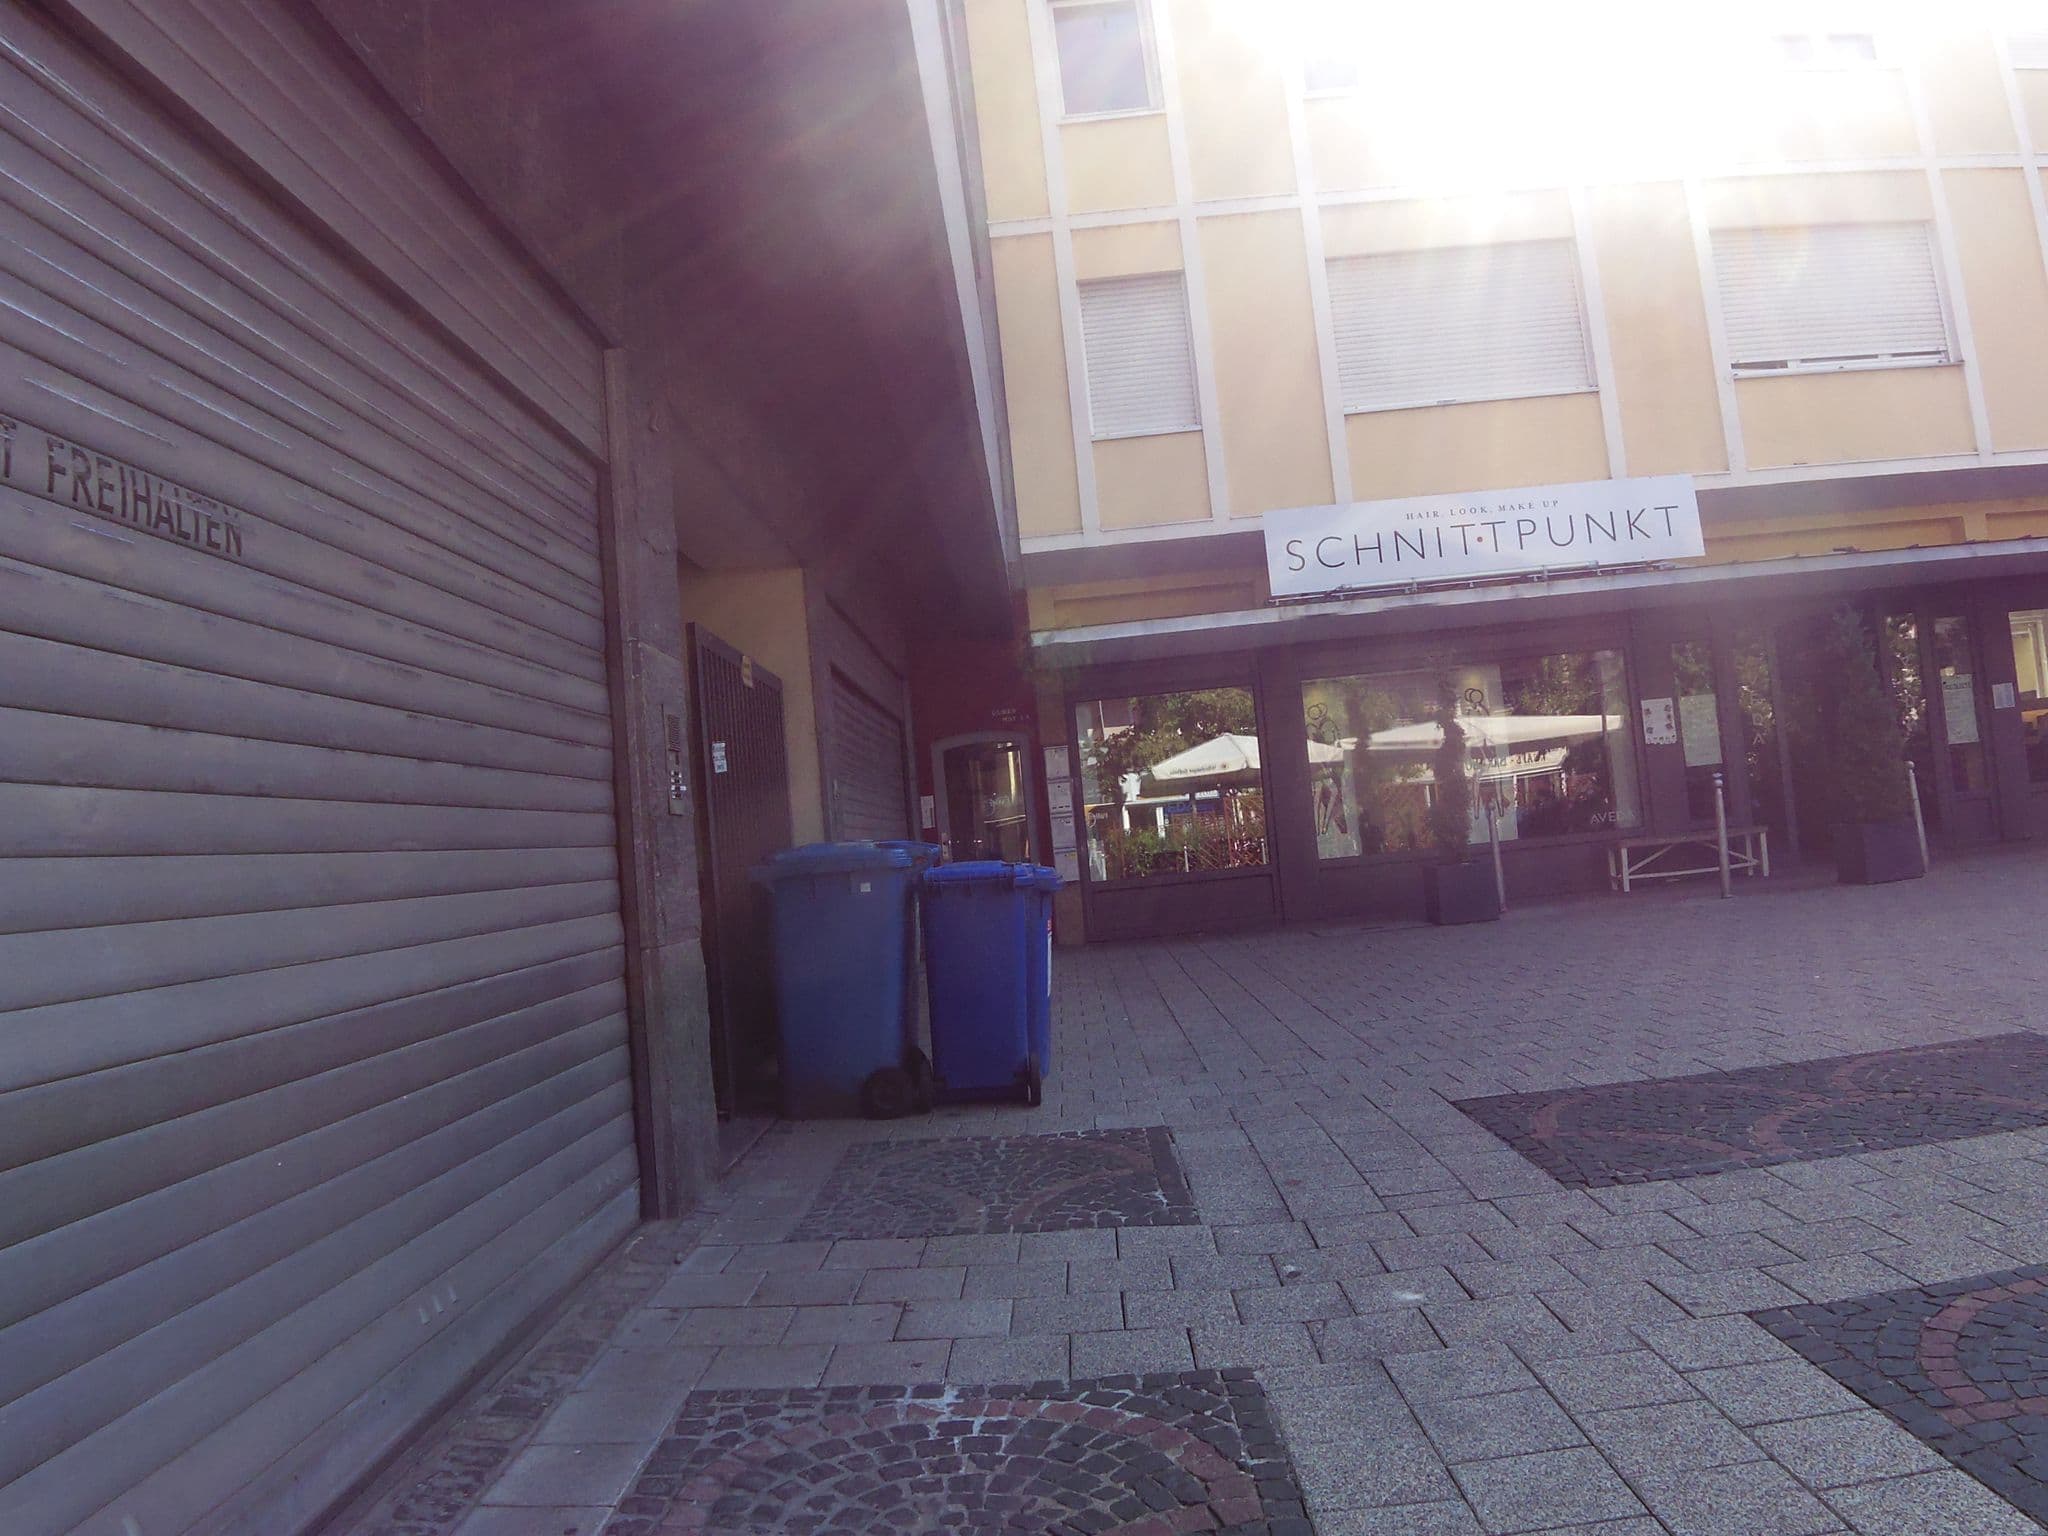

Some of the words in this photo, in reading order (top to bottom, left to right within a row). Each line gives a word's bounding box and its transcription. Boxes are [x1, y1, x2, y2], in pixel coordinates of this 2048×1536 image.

[46, 436, 243, 557] FREIHALTEN
[1498, 502, 1535, 512] MAKE
[1542, 499, 1559, 508] UP
